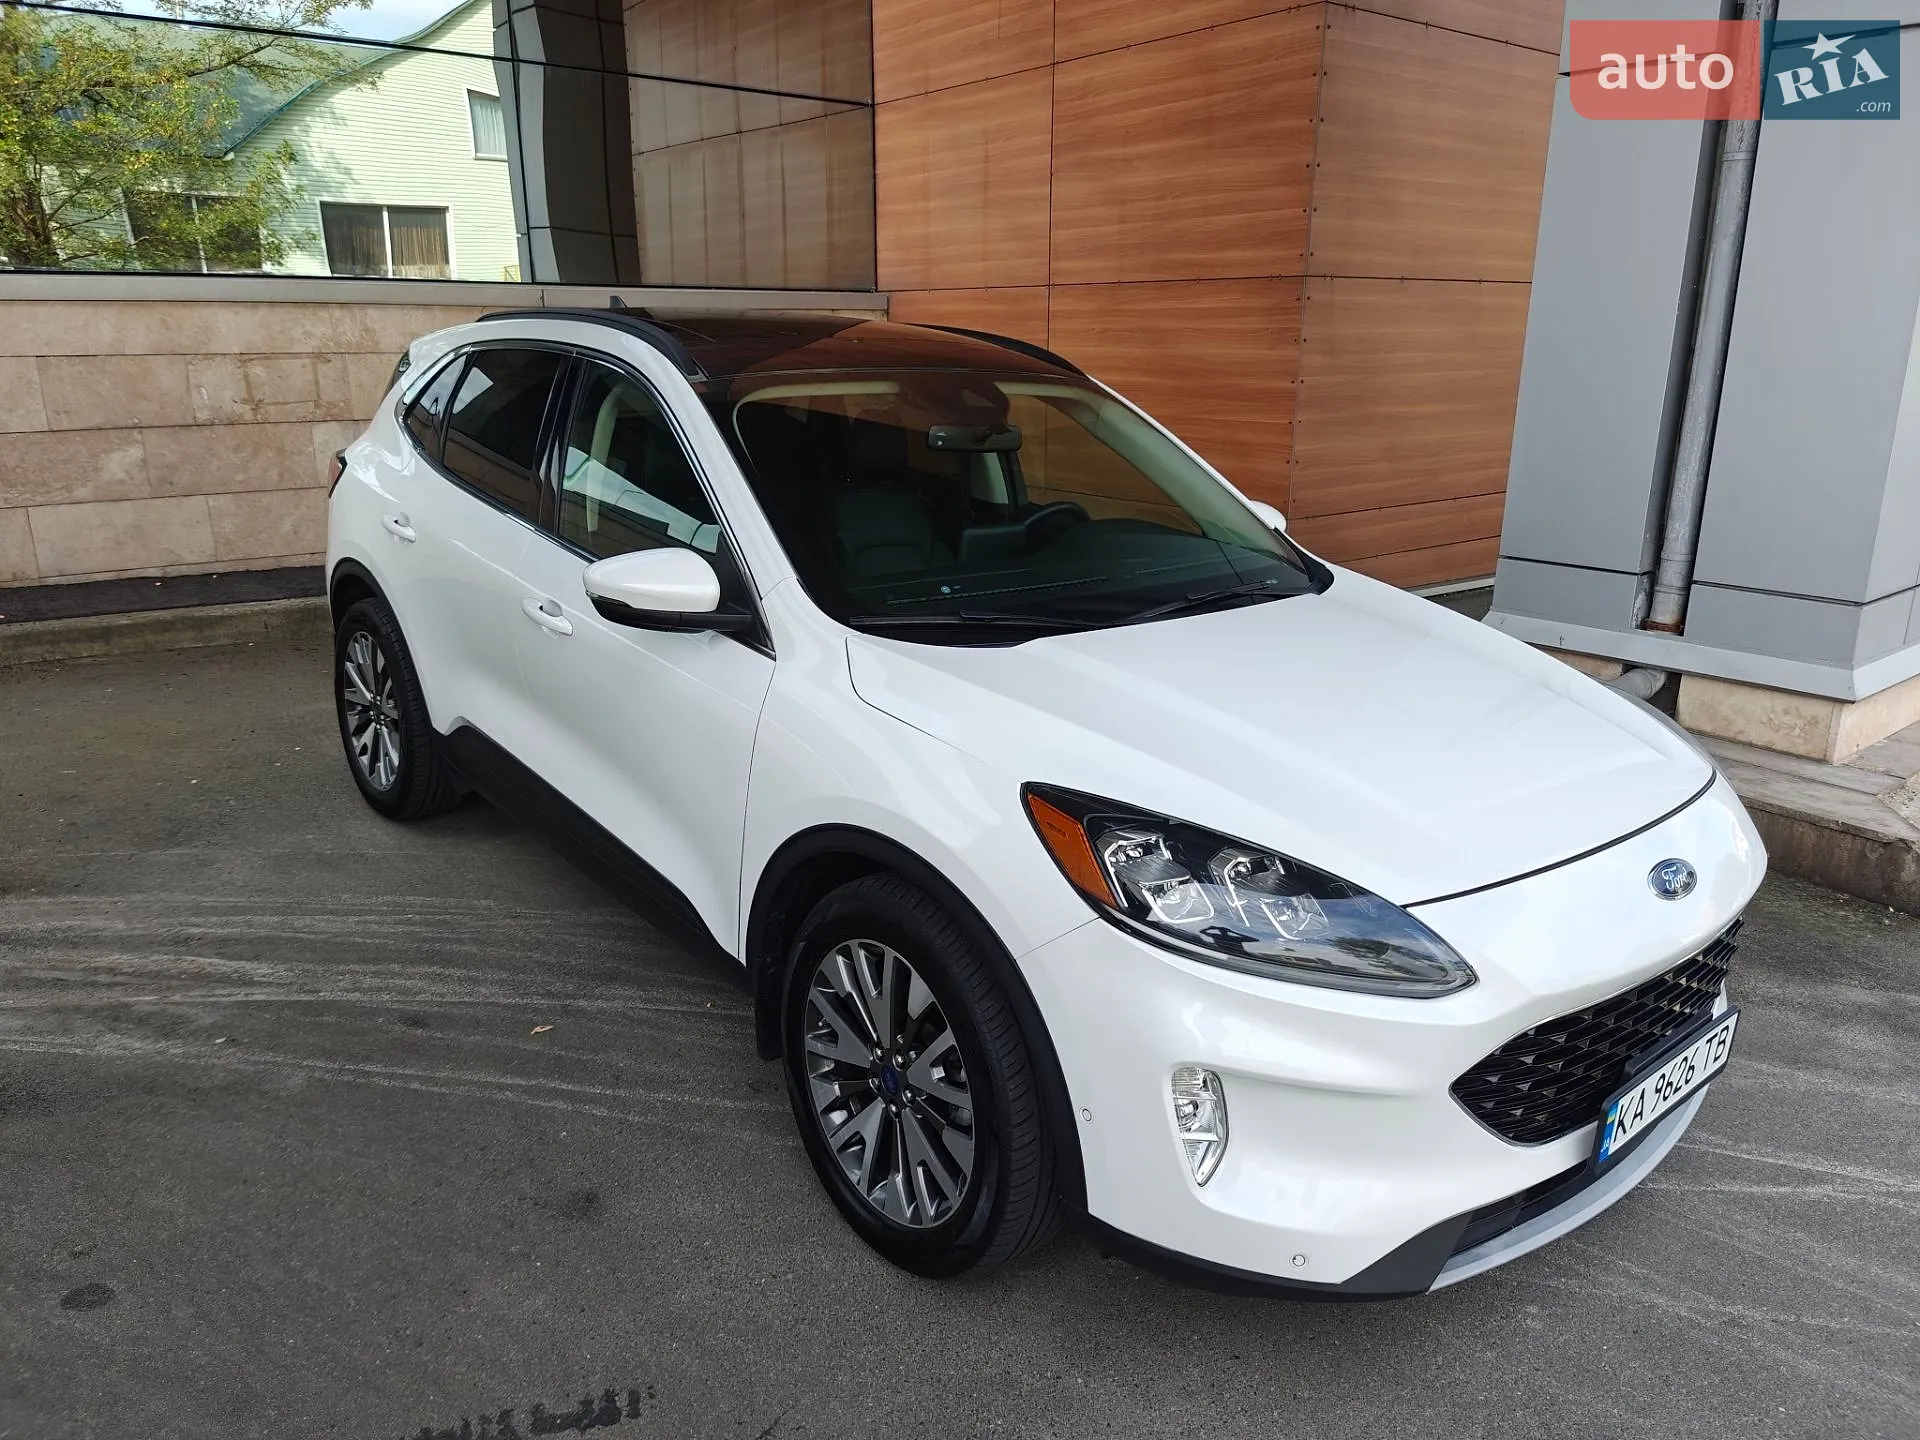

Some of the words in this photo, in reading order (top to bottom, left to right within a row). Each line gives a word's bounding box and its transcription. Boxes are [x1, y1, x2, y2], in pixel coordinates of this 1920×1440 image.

[1613, 1087, 1646, 1143] KA
[1650, 1047, 1699, 1113] 9626
[1703, 1024, 1730, 1071] TB
